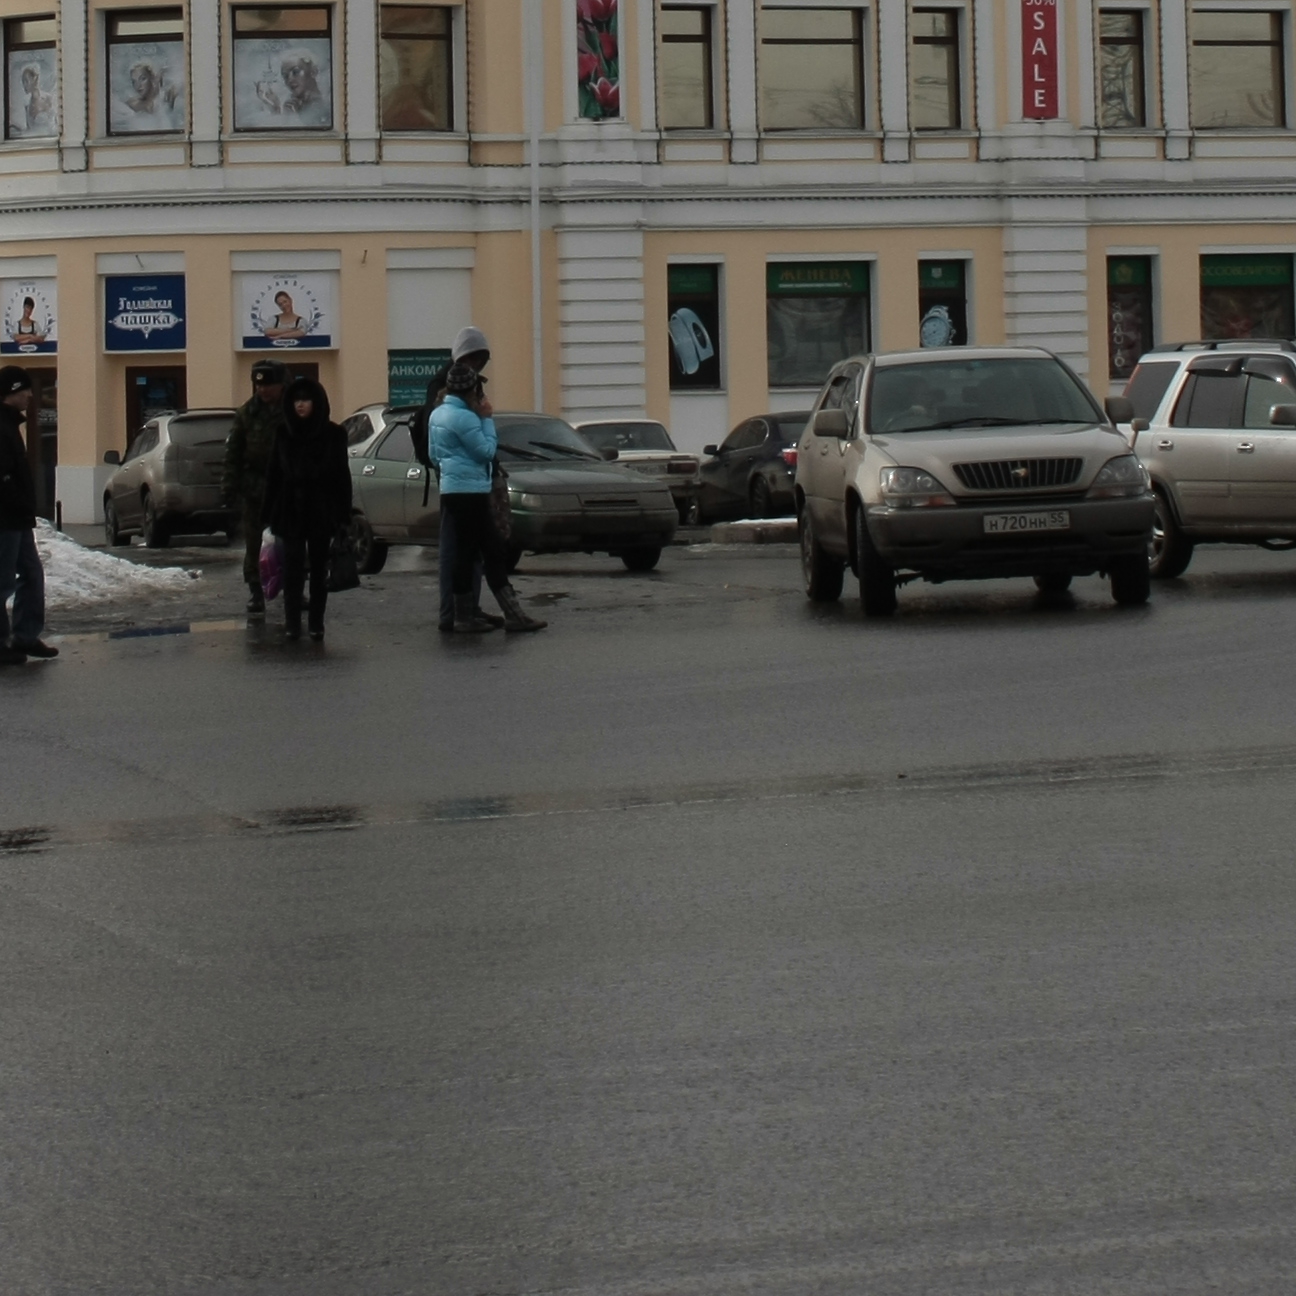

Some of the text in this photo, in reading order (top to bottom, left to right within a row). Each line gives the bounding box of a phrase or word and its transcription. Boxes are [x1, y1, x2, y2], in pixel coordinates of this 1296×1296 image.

[1032, 11, 1047, 108] SALE
[780, 269, 852, 282] ЖЕНЕВА
[989, 511, 1064, 531] Н720НН 55
